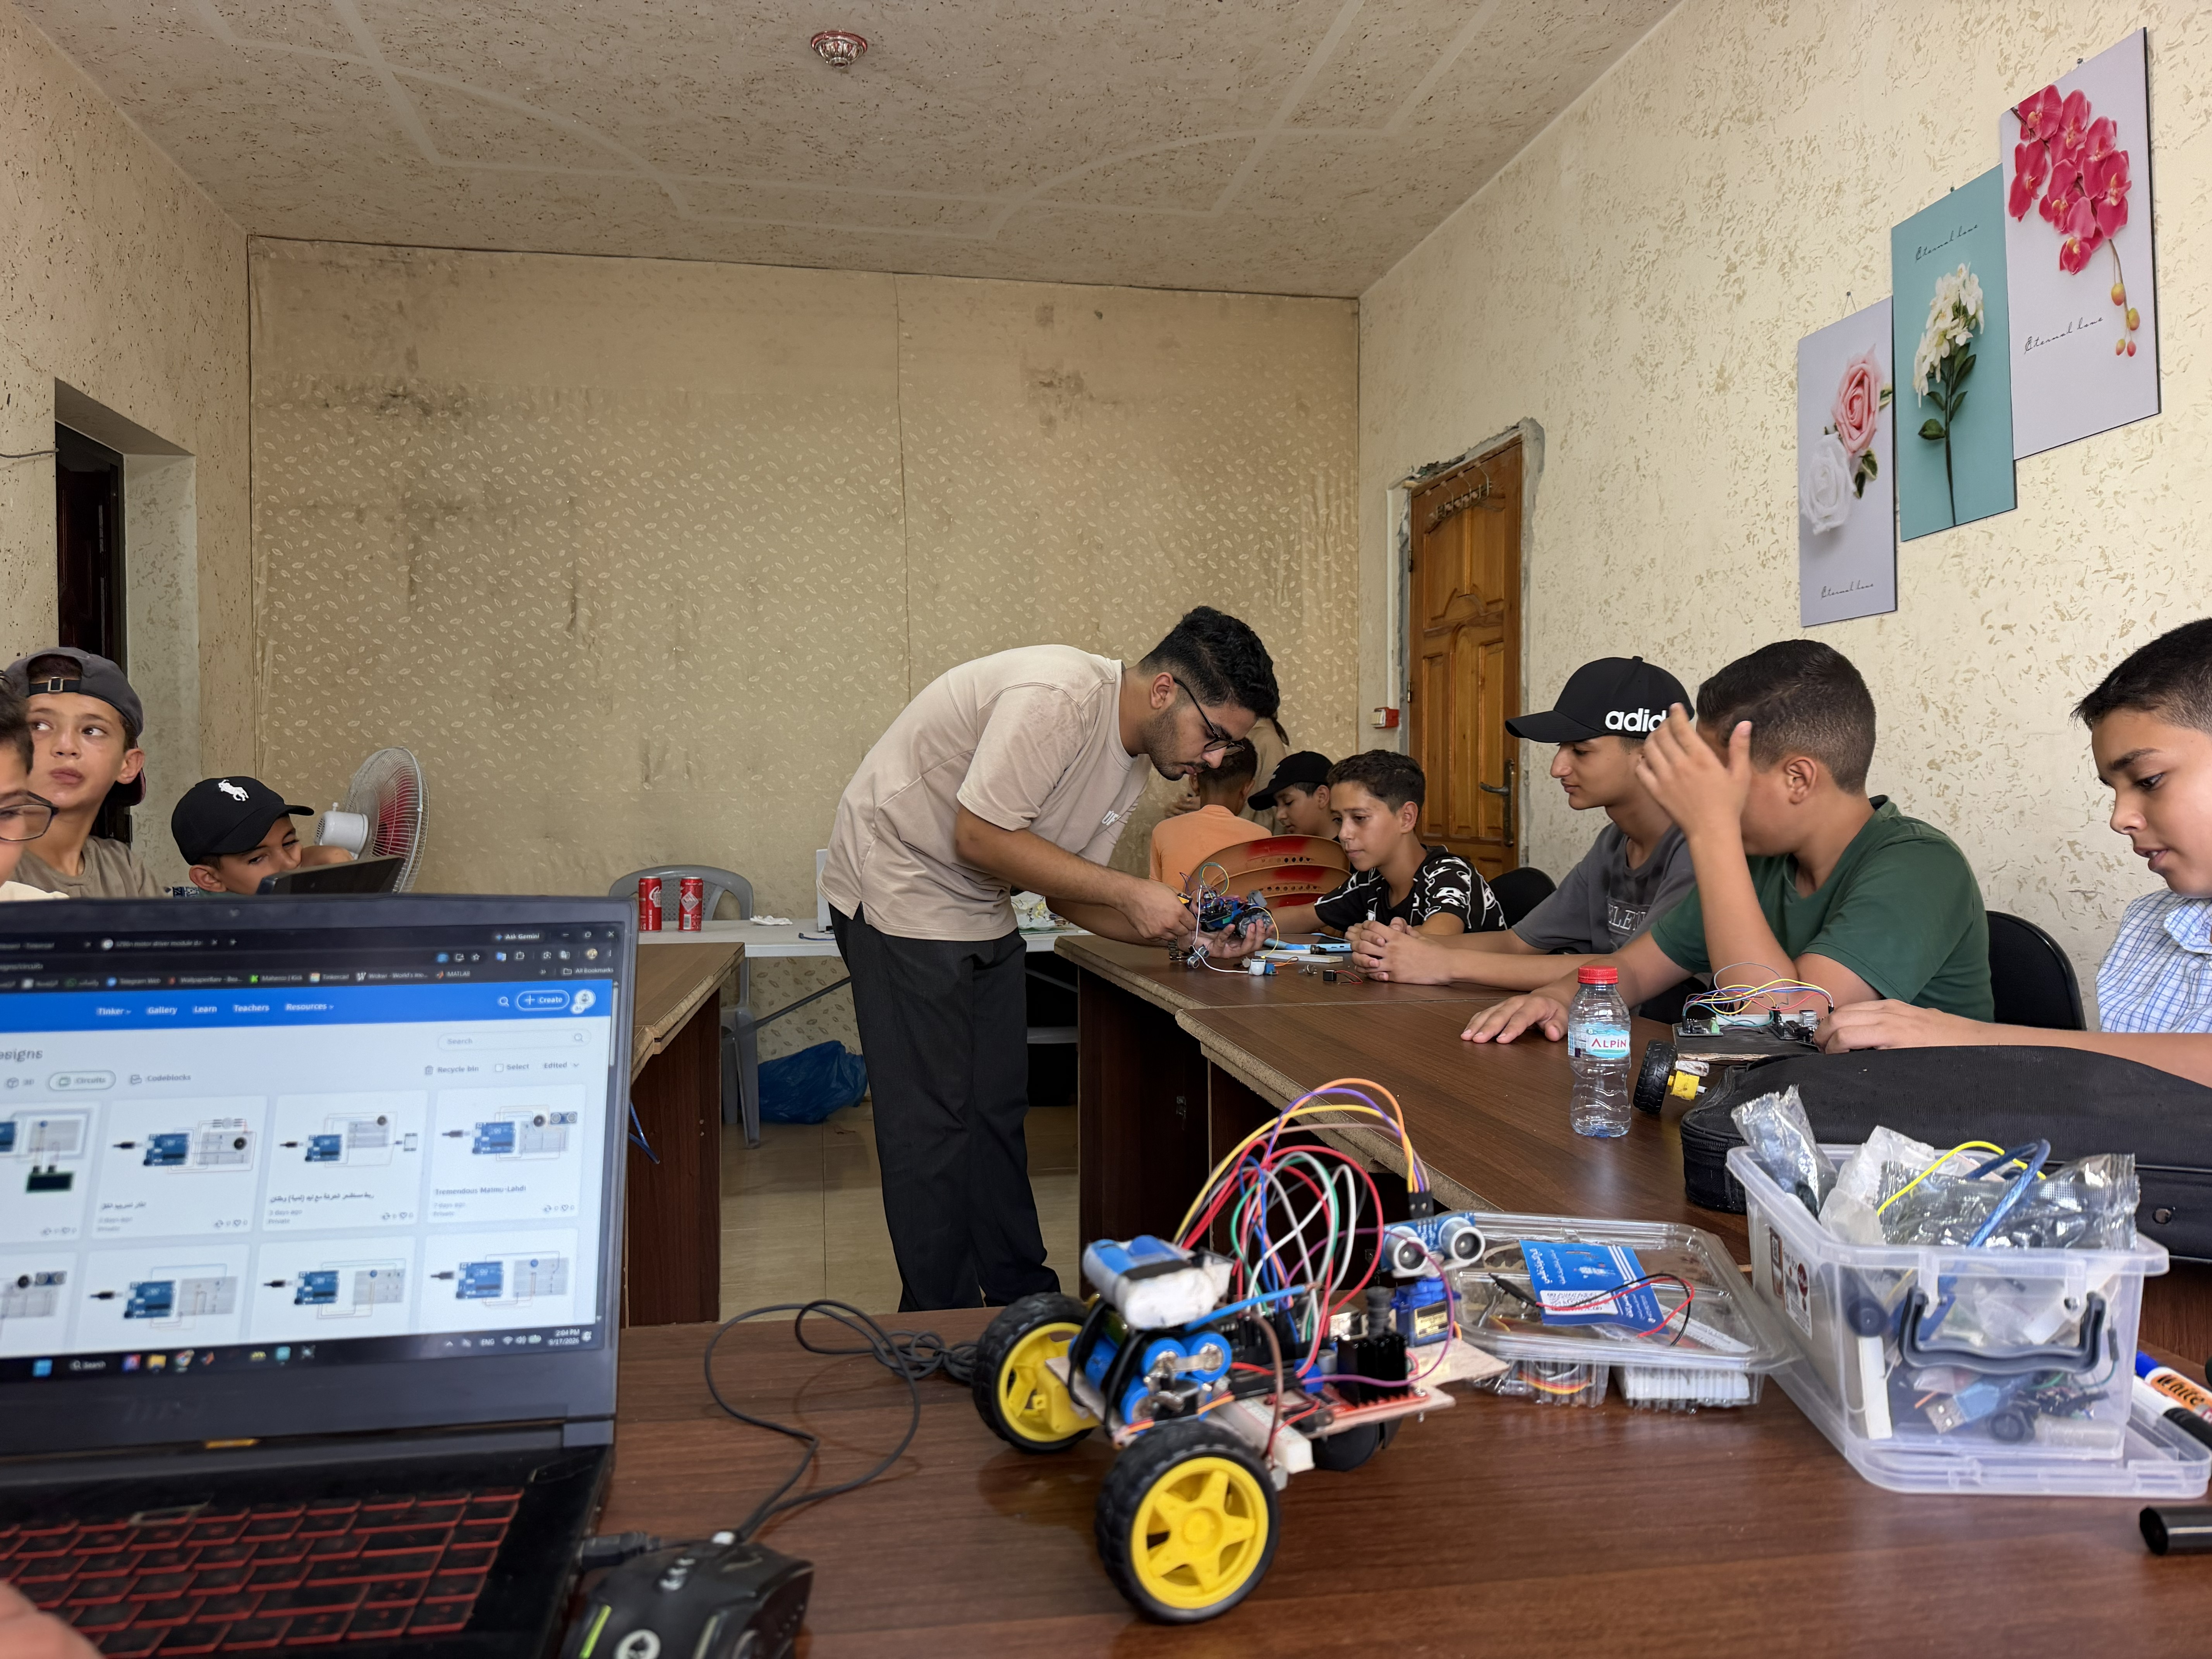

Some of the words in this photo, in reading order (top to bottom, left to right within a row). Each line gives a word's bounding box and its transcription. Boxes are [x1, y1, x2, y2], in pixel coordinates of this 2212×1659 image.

[2024, 321, 2073, 354] Eternal
[1605, 708, 1669, 732] adid
[98, 1007, 124, 1015] Tinker
[193, 1005, 217, 1013] Learn
[234, 1004, 270, 1013] Teachers
[285, 1002, 327, 1011] Resources
[147, 1007, 177, 1016] Gallery
[147, 1074, 191, 1082] Codeblocks
[82, 1361, 106, 1369] Search
